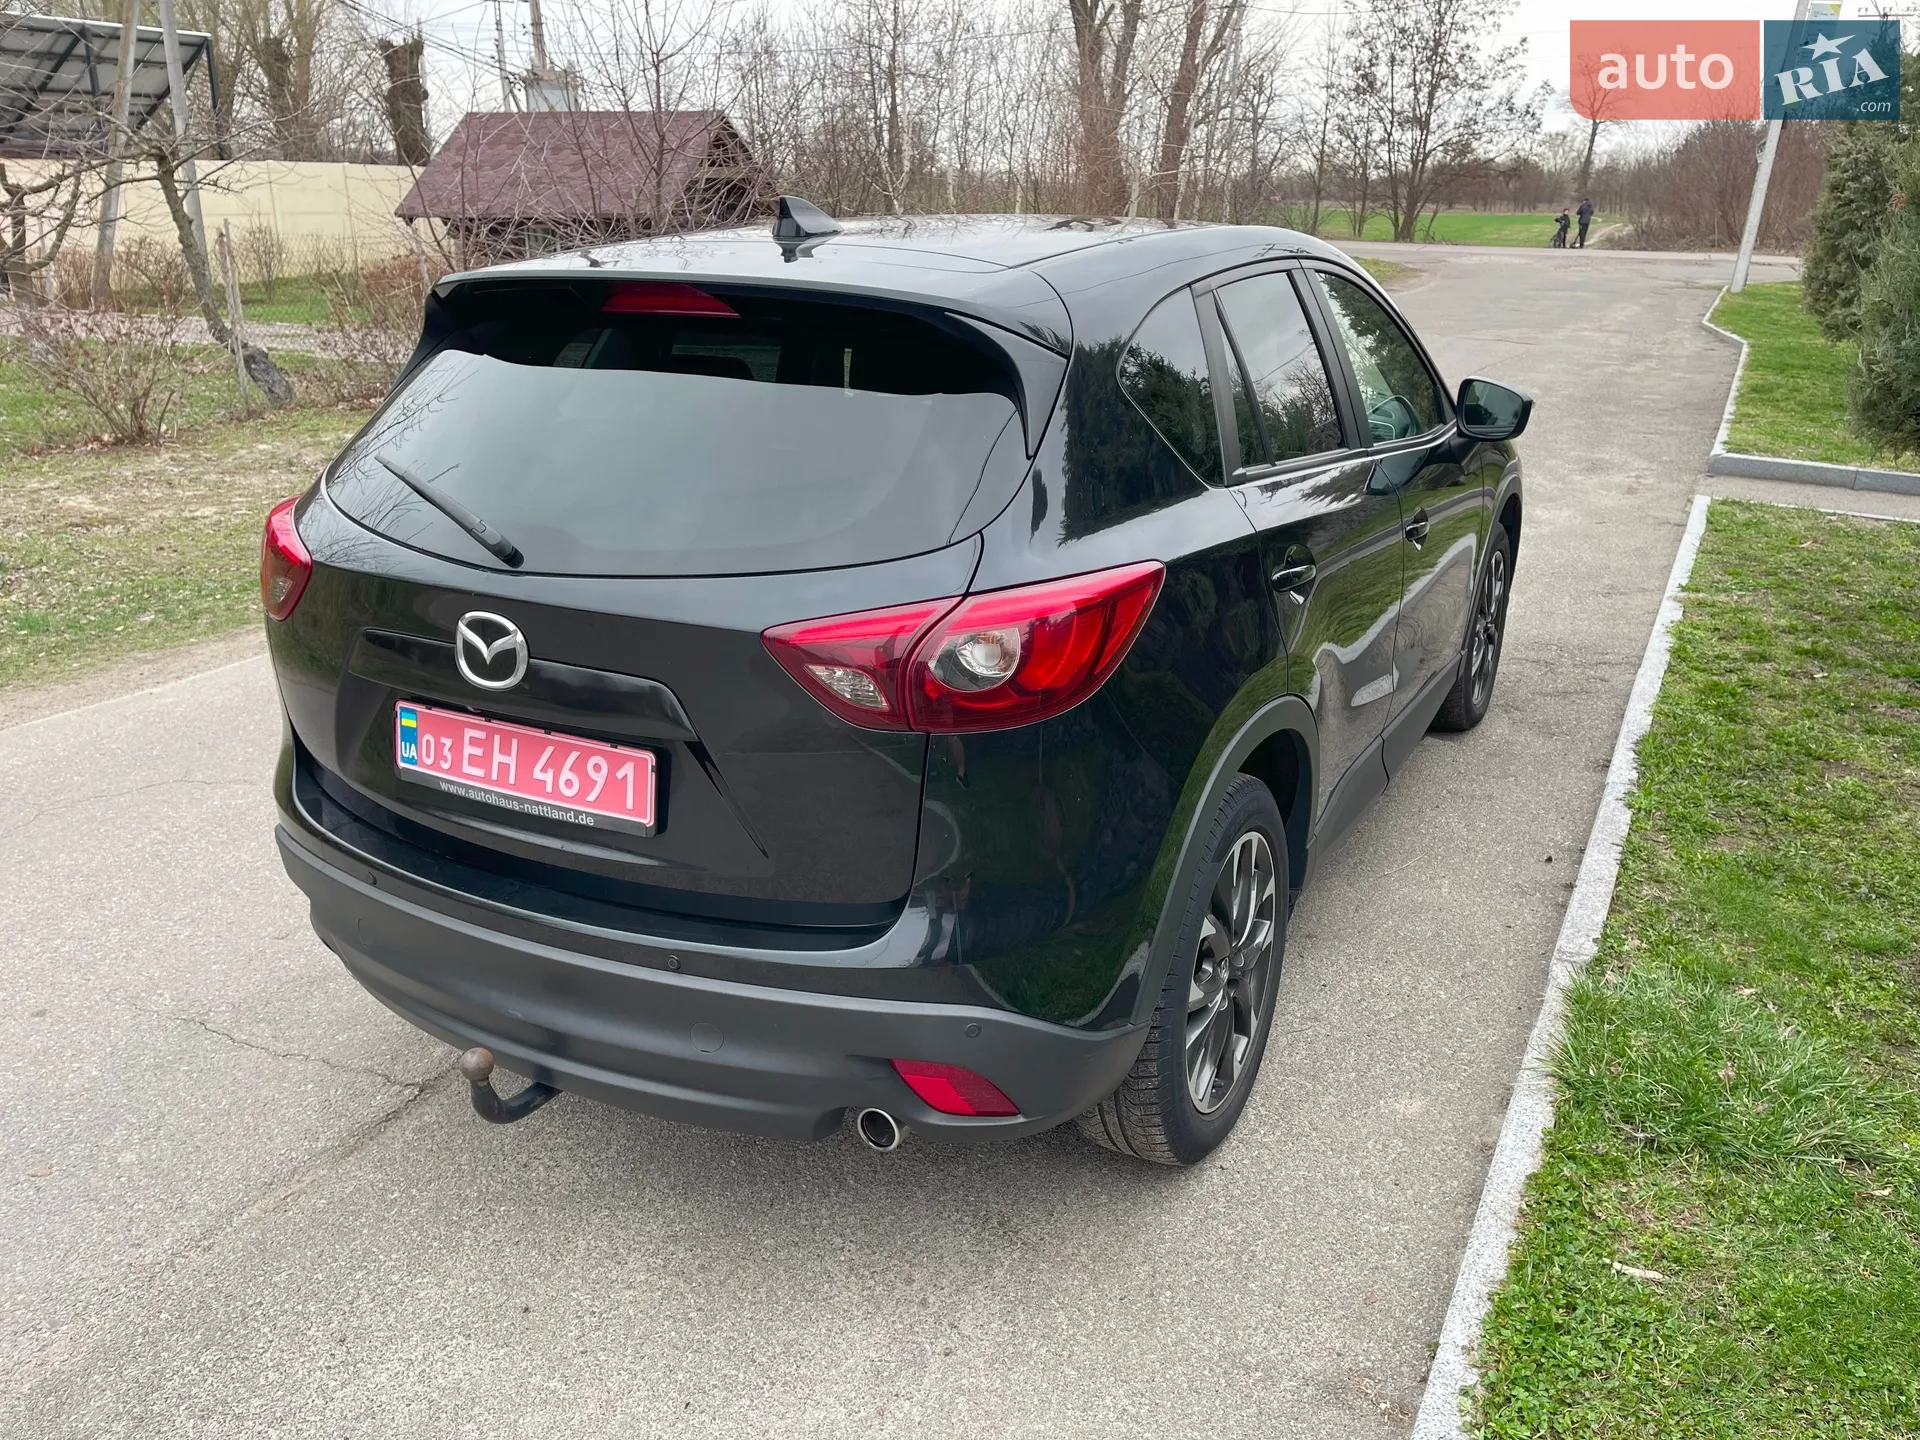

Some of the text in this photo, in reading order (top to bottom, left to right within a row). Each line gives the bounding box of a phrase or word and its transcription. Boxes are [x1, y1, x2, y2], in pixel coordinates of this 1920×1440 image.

[401, 742, 418, 760] UA
[421, 727, 635, 810] 03 EH 4691
[439, 781, 595, 826] www.autohaus-nattland.de
